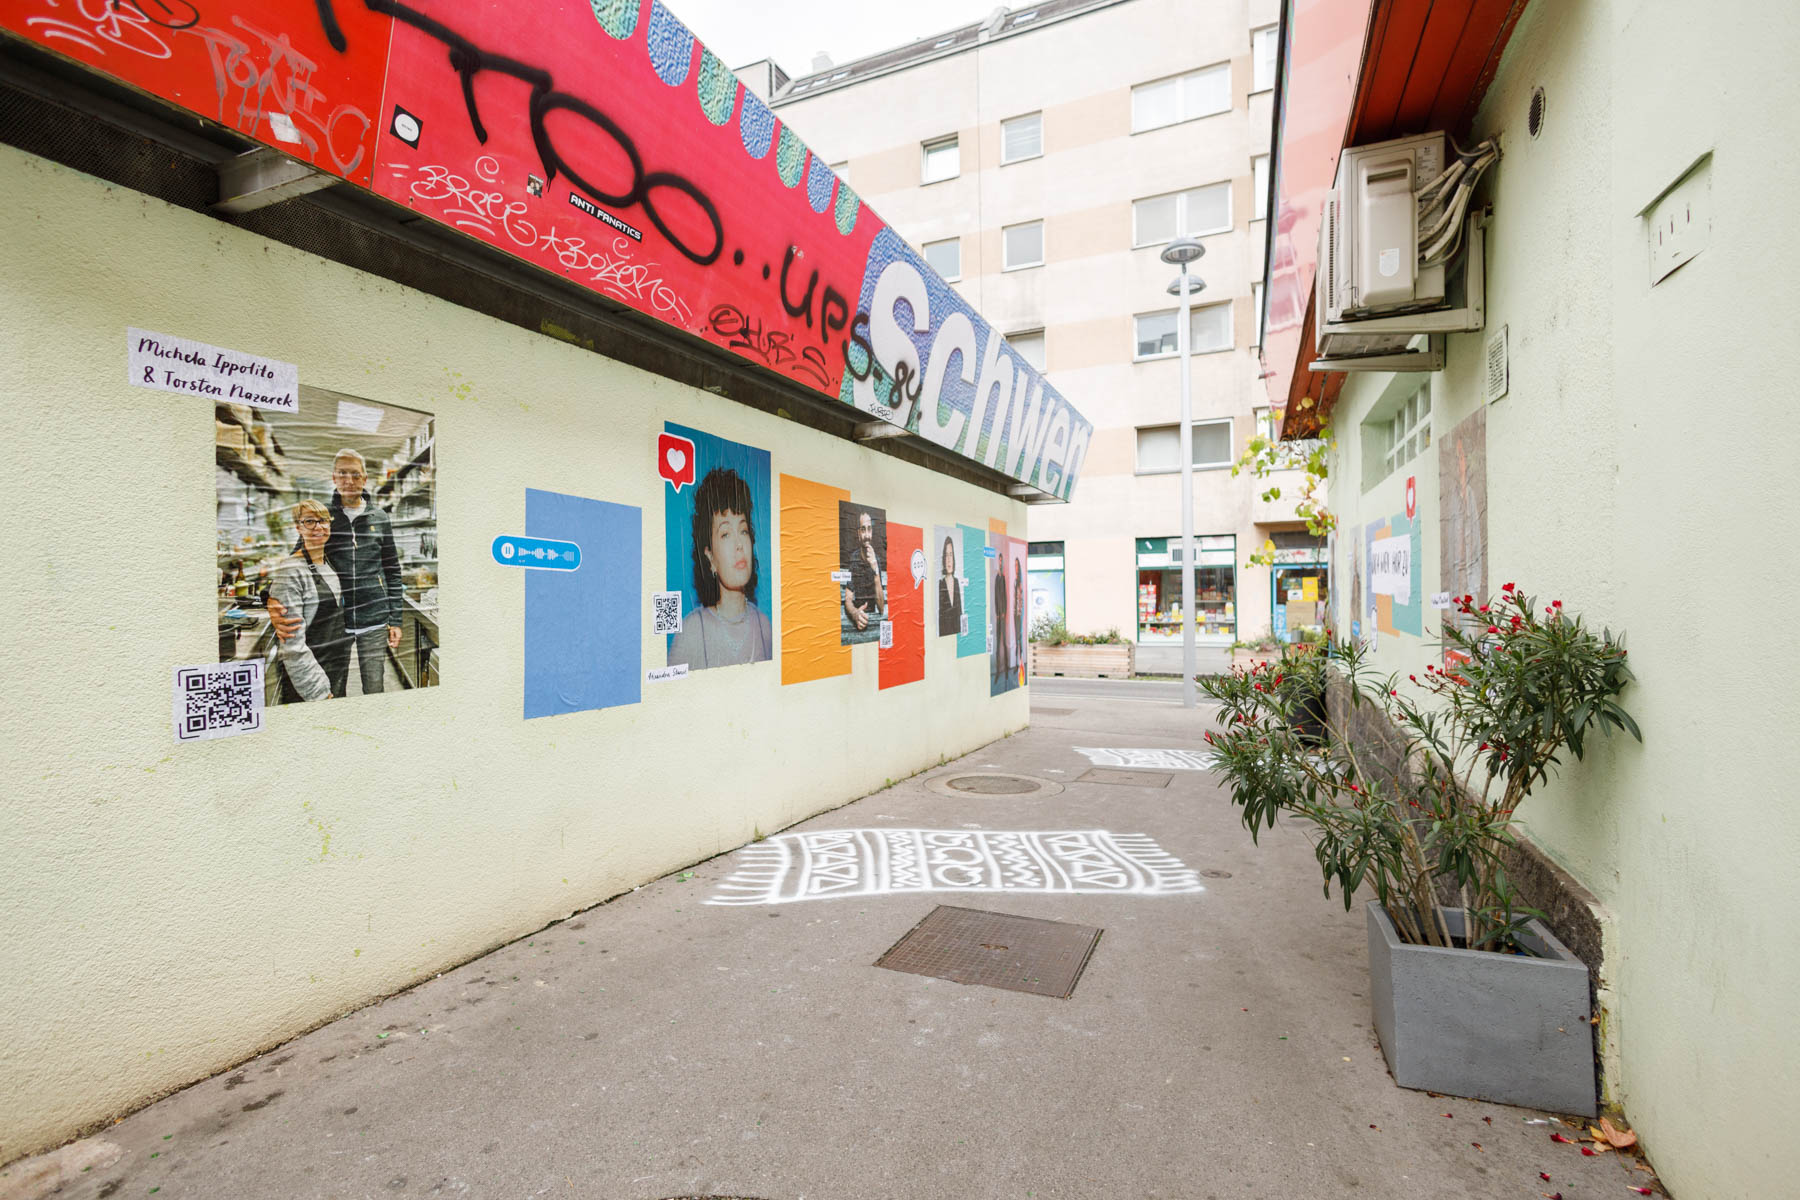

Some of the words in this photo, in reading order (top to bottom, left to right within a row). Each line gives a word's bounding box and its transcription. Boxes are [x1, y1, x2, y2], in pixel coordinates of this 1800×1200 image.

[570, 194, 595, 214] ANTI
[597, 209, 641, 240] FANATICS
[138, 337, 206, 366] Michela
[212, 353, 274, 380] Ippolito
[143, 365, 155, 383] &
[164, 370, 223, 396] Torsten
[229, 383, 293, 408] Nazarek
